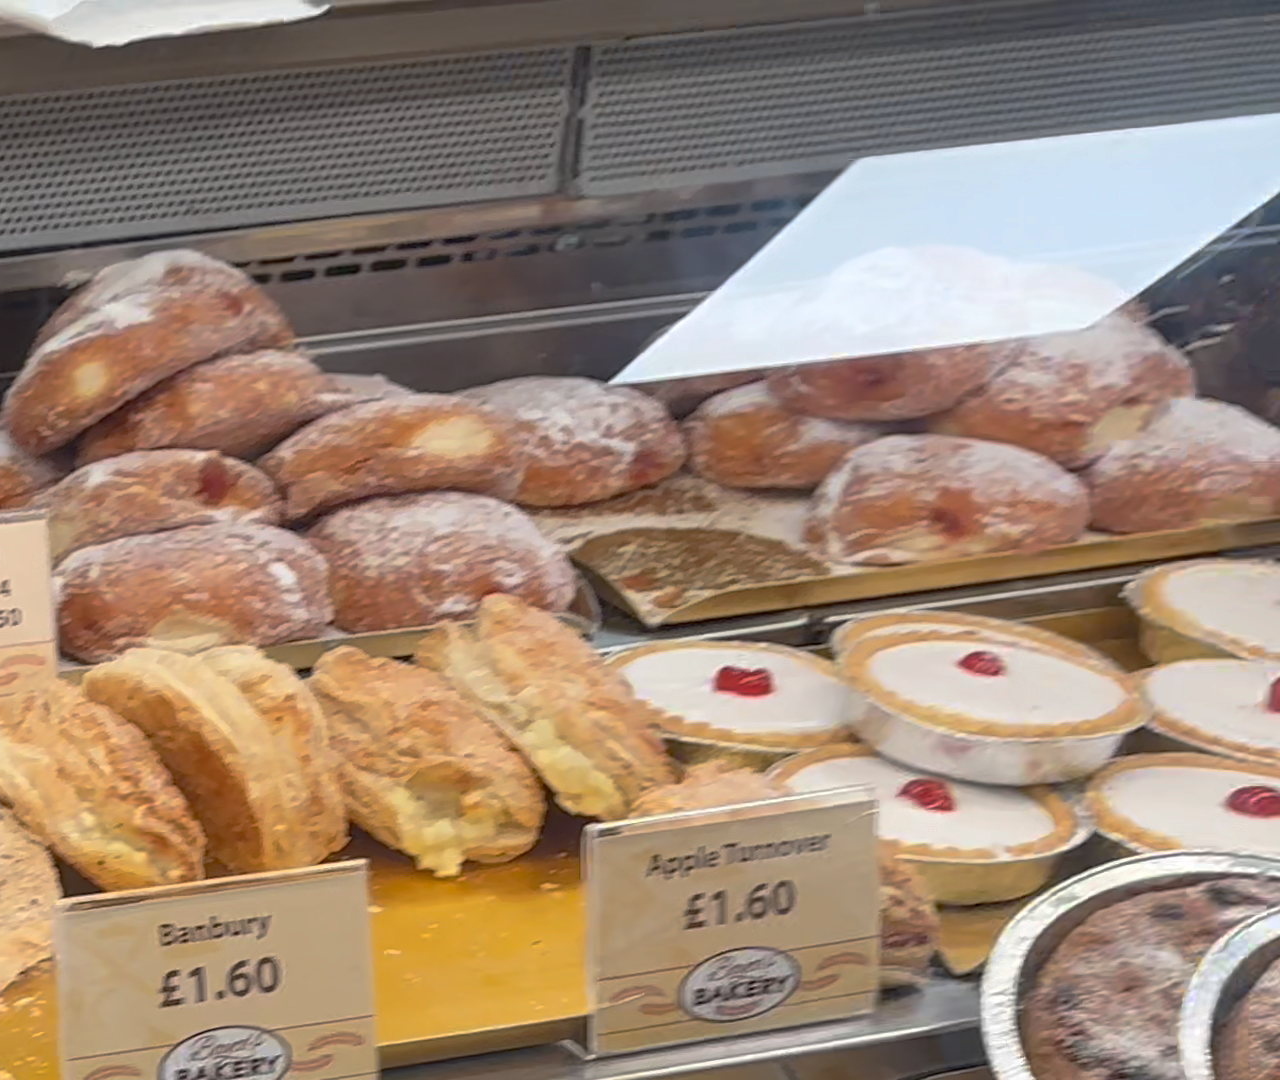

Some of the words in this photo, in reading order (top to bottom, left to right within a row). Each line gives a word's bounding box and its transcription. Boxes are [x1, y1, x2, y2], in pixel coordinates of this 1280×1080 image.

[645, 846, 719, 880] Apple
[720, 832, 833, 867] Turnover
[682, 879, 799, 931] £1.60
[157, 913, 273, 948] Banbury
[158, 955, 281, 1010] £1.60
[692, 971, 797, 1007] BAKERY
